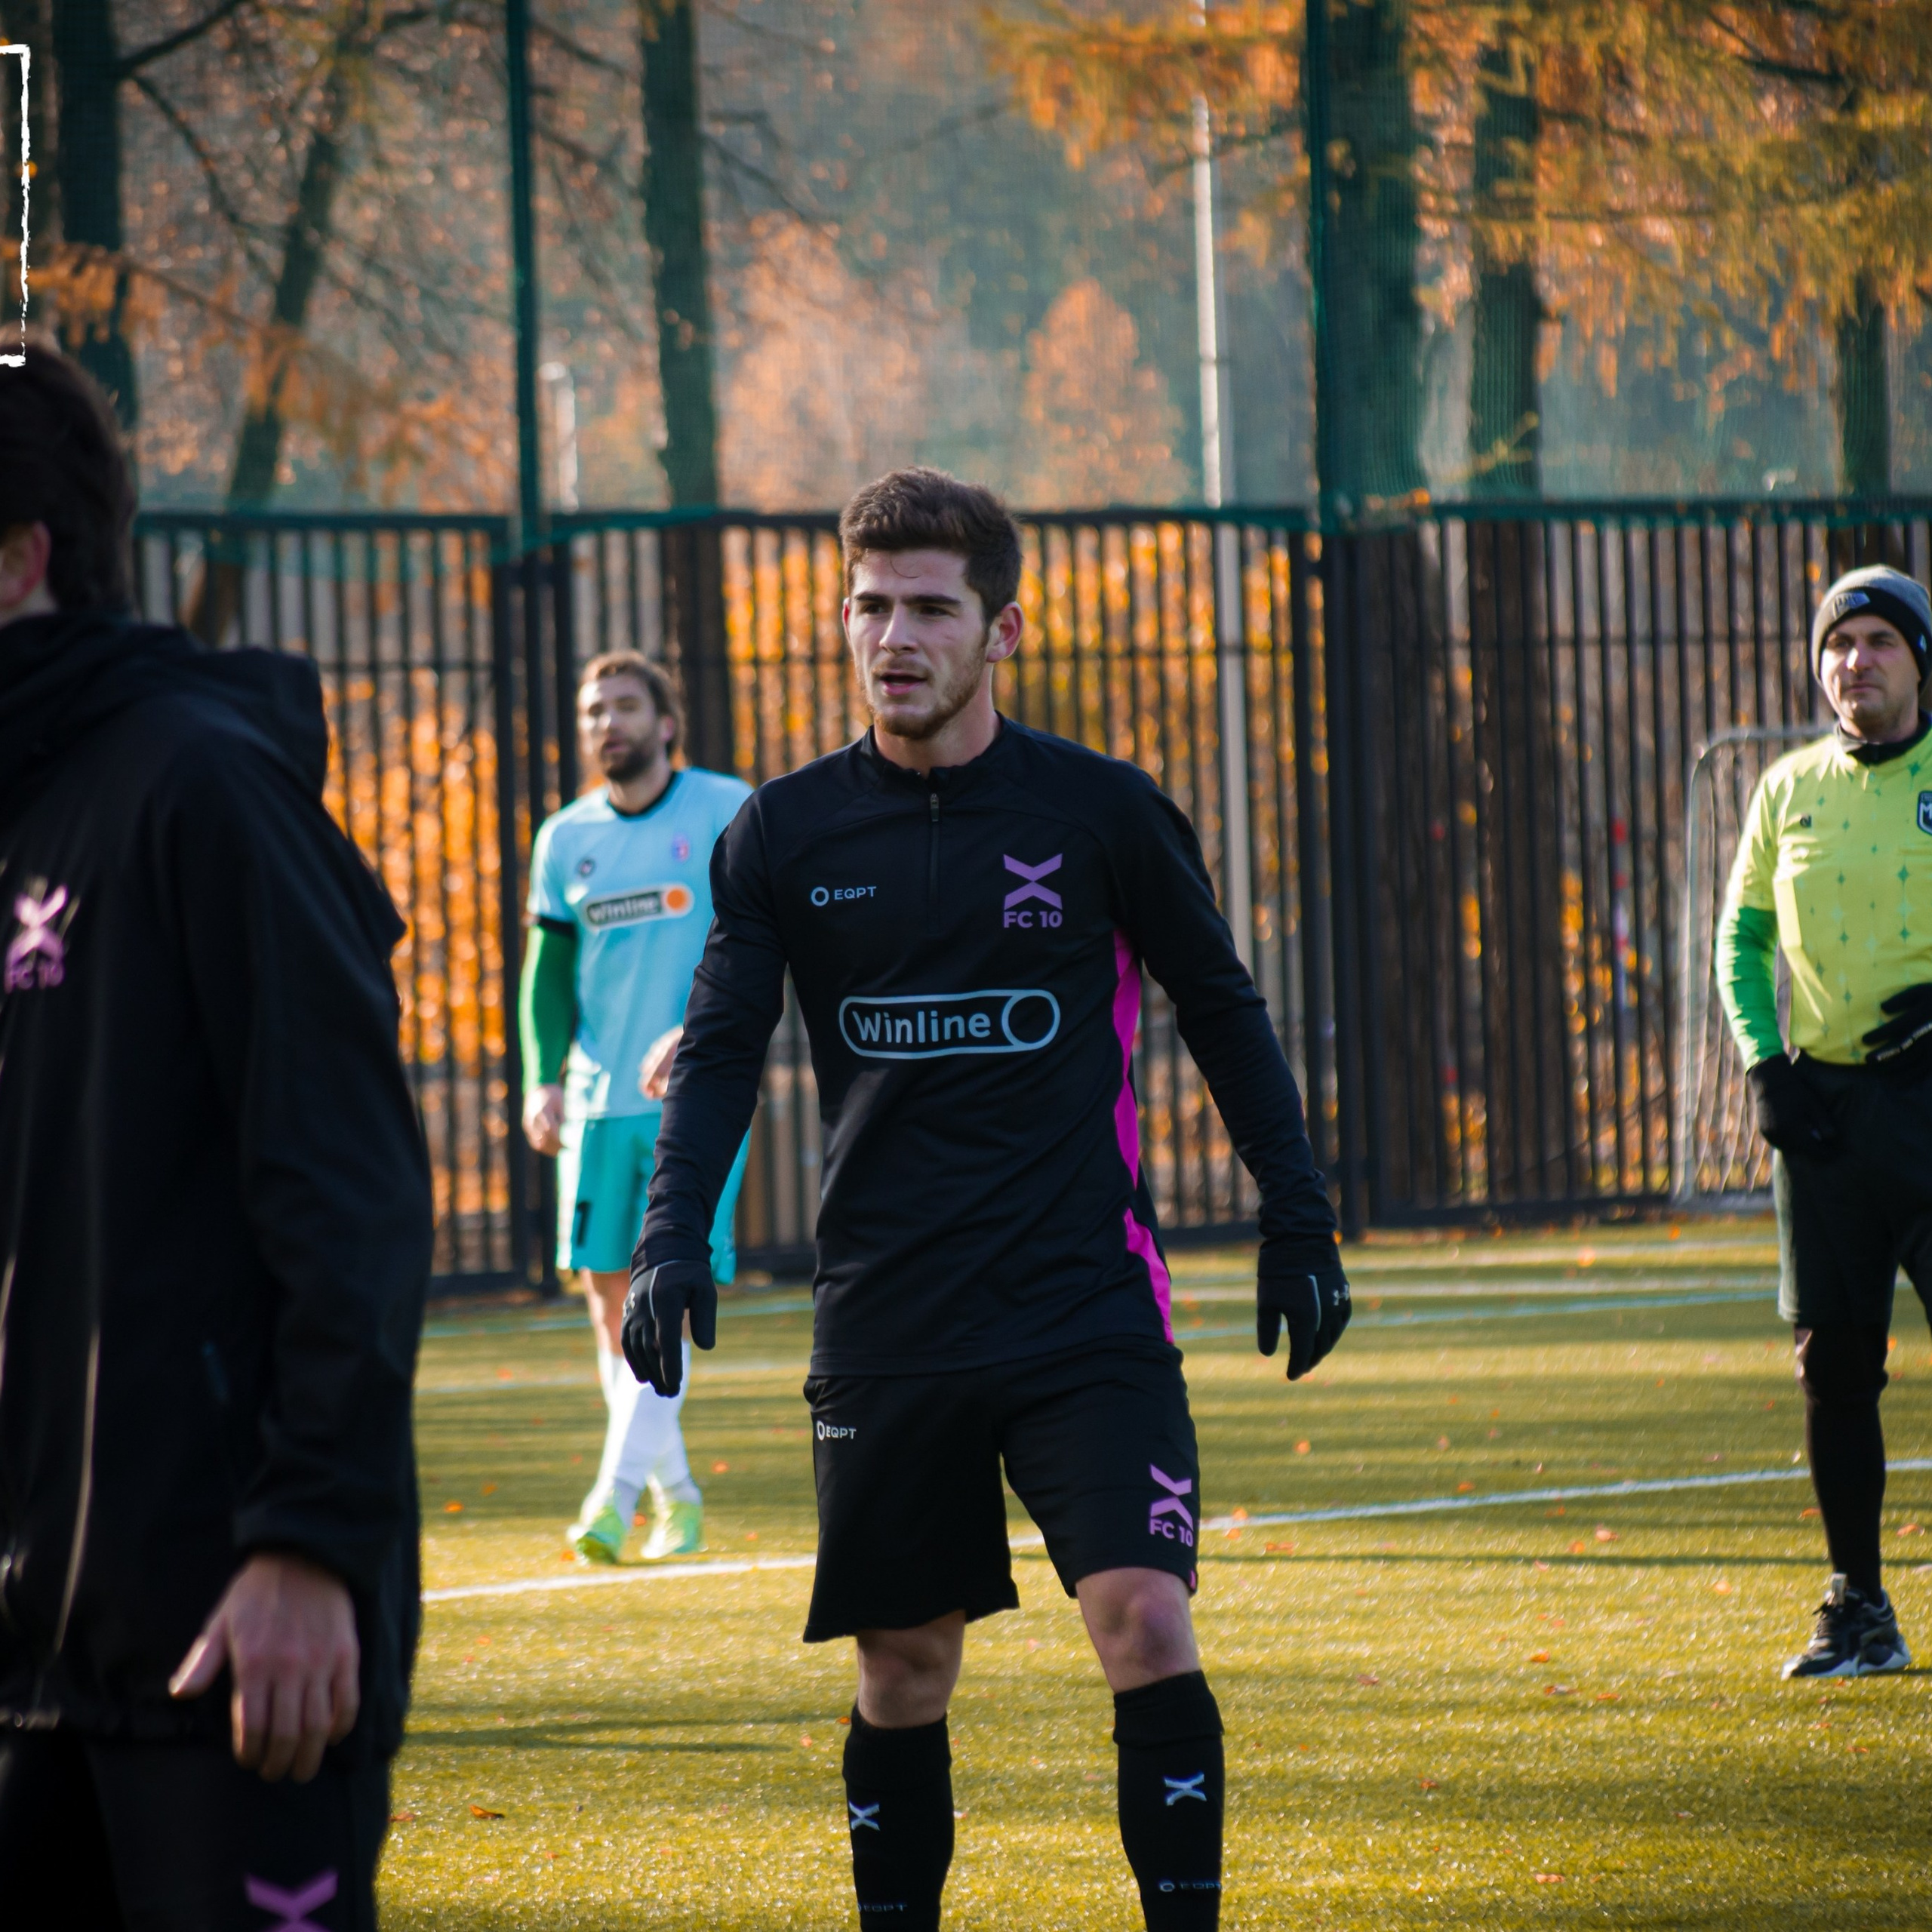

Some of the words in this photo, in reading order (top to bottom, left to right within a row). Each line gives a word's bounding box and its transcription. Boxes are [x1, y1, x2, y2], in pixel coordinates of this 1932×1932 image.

[834, 886, 877, 900] EQPT
[1004, 911, 1033, 928] FC
[1039, 910, 1063, 928] 10
[852, 1010, 991, 1044] Winline
[826, 1425, 857, 1440] EQPT
[1149, 1518, 1175, 1539] FC
[1179, 1525, 1193, 1547] 10
